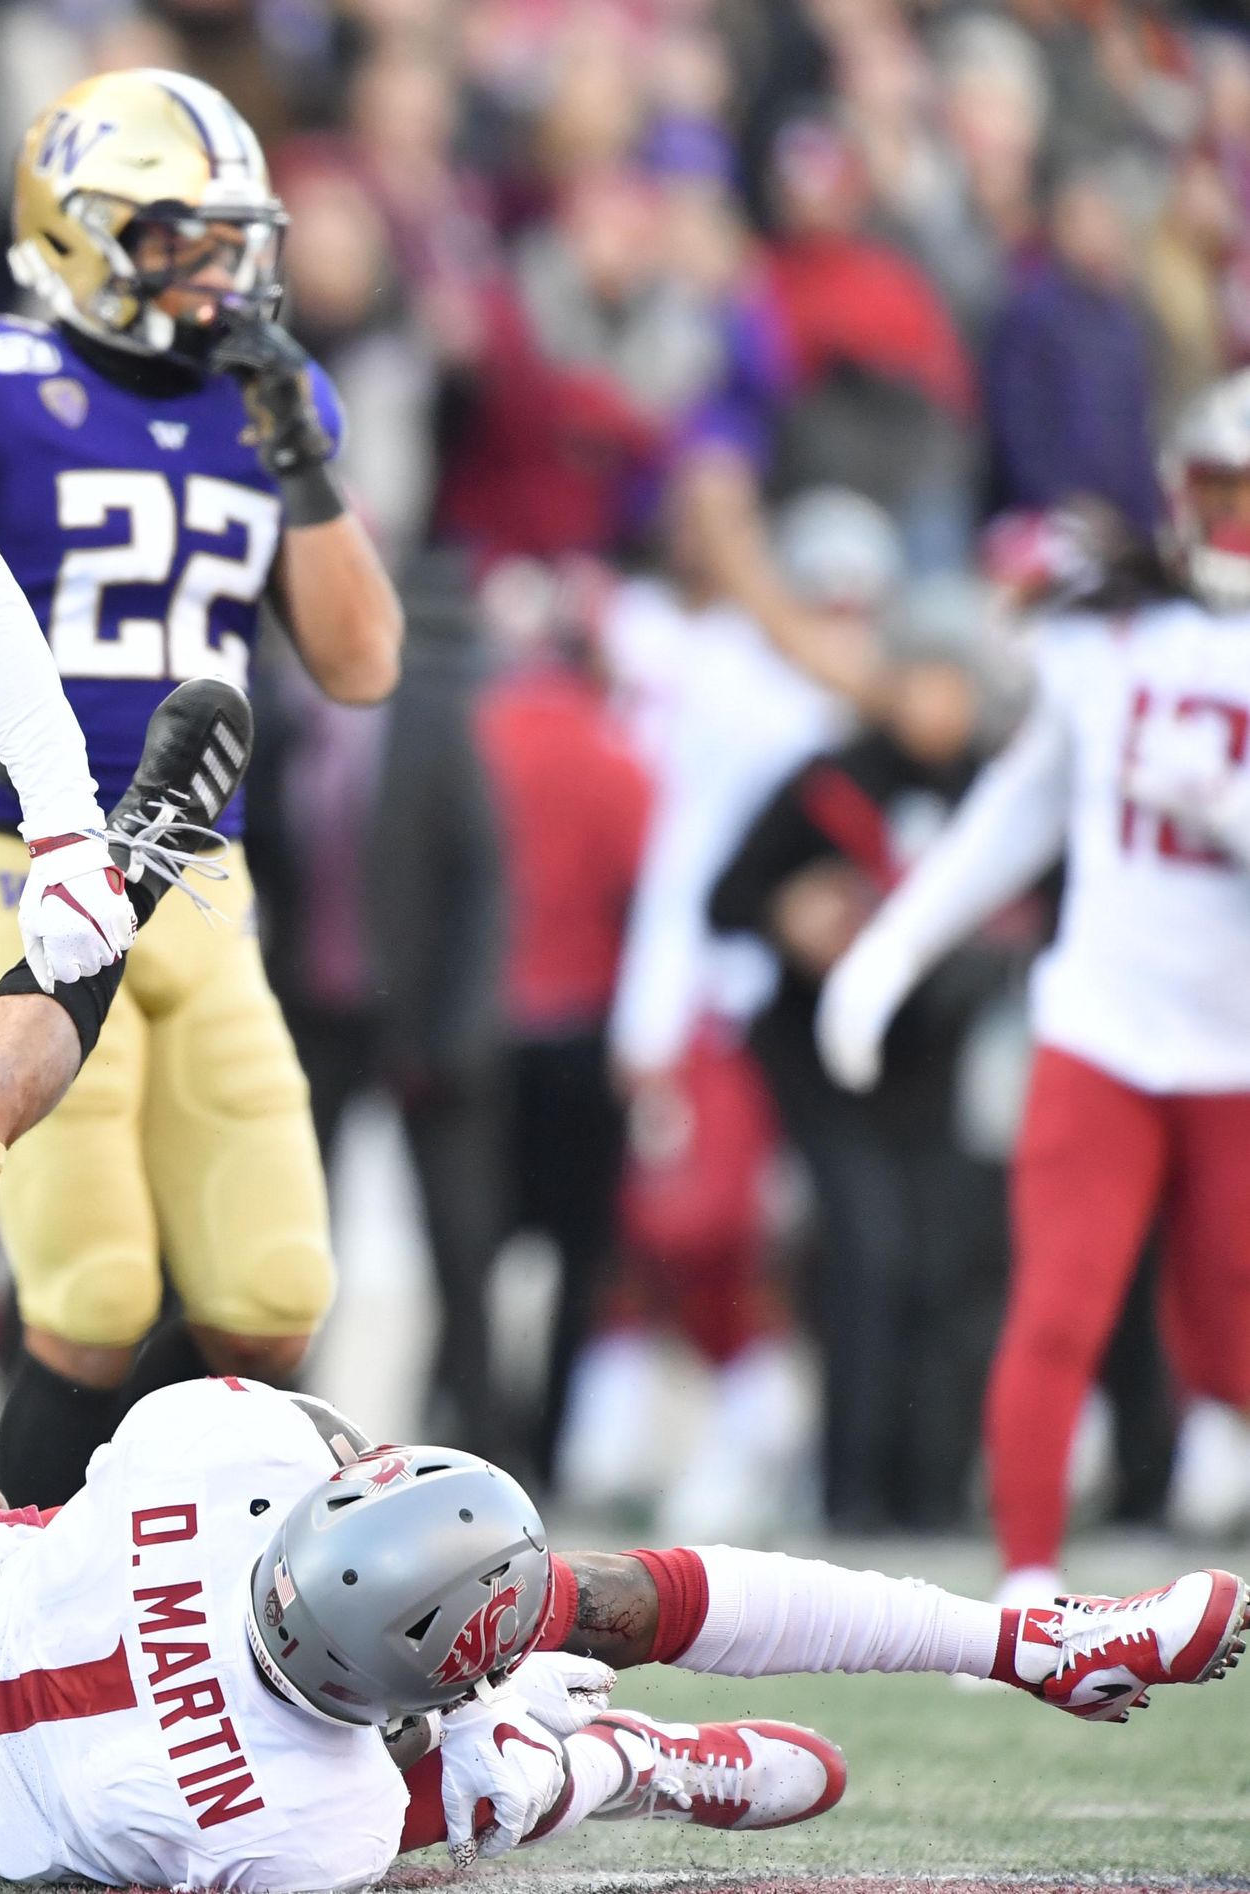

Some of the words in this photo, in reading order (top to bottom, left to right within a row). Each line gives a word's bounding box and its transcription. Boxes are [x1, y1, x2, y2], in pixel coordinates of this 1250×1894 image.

[37, 111, 117, 177] W
[52, 469, 283, 688] 22
[131, 1502, 198, 1567] D.
[133, 1579, 266, 1830] MARTIN
